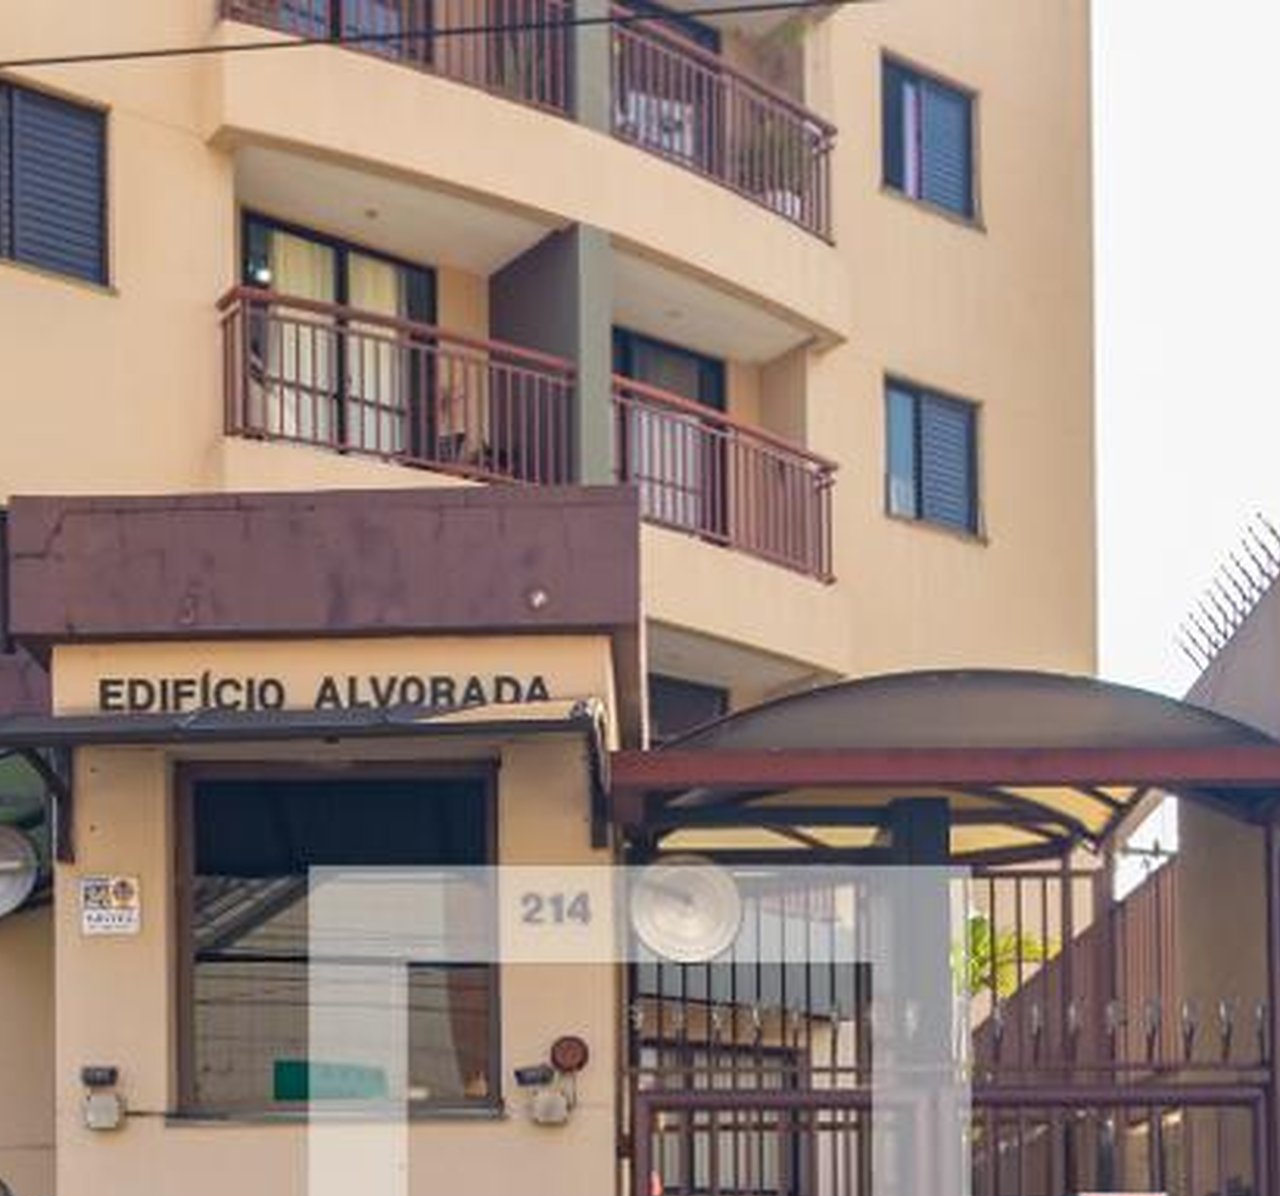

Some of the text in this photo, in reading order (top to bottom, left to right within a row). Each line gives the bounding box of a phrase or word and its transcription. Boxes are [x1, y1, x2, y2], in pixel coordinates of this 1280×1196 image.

[98, 670, 551, 711] EDIFÍCIO ALVORADA
[521, 891, 592, 926] 214
